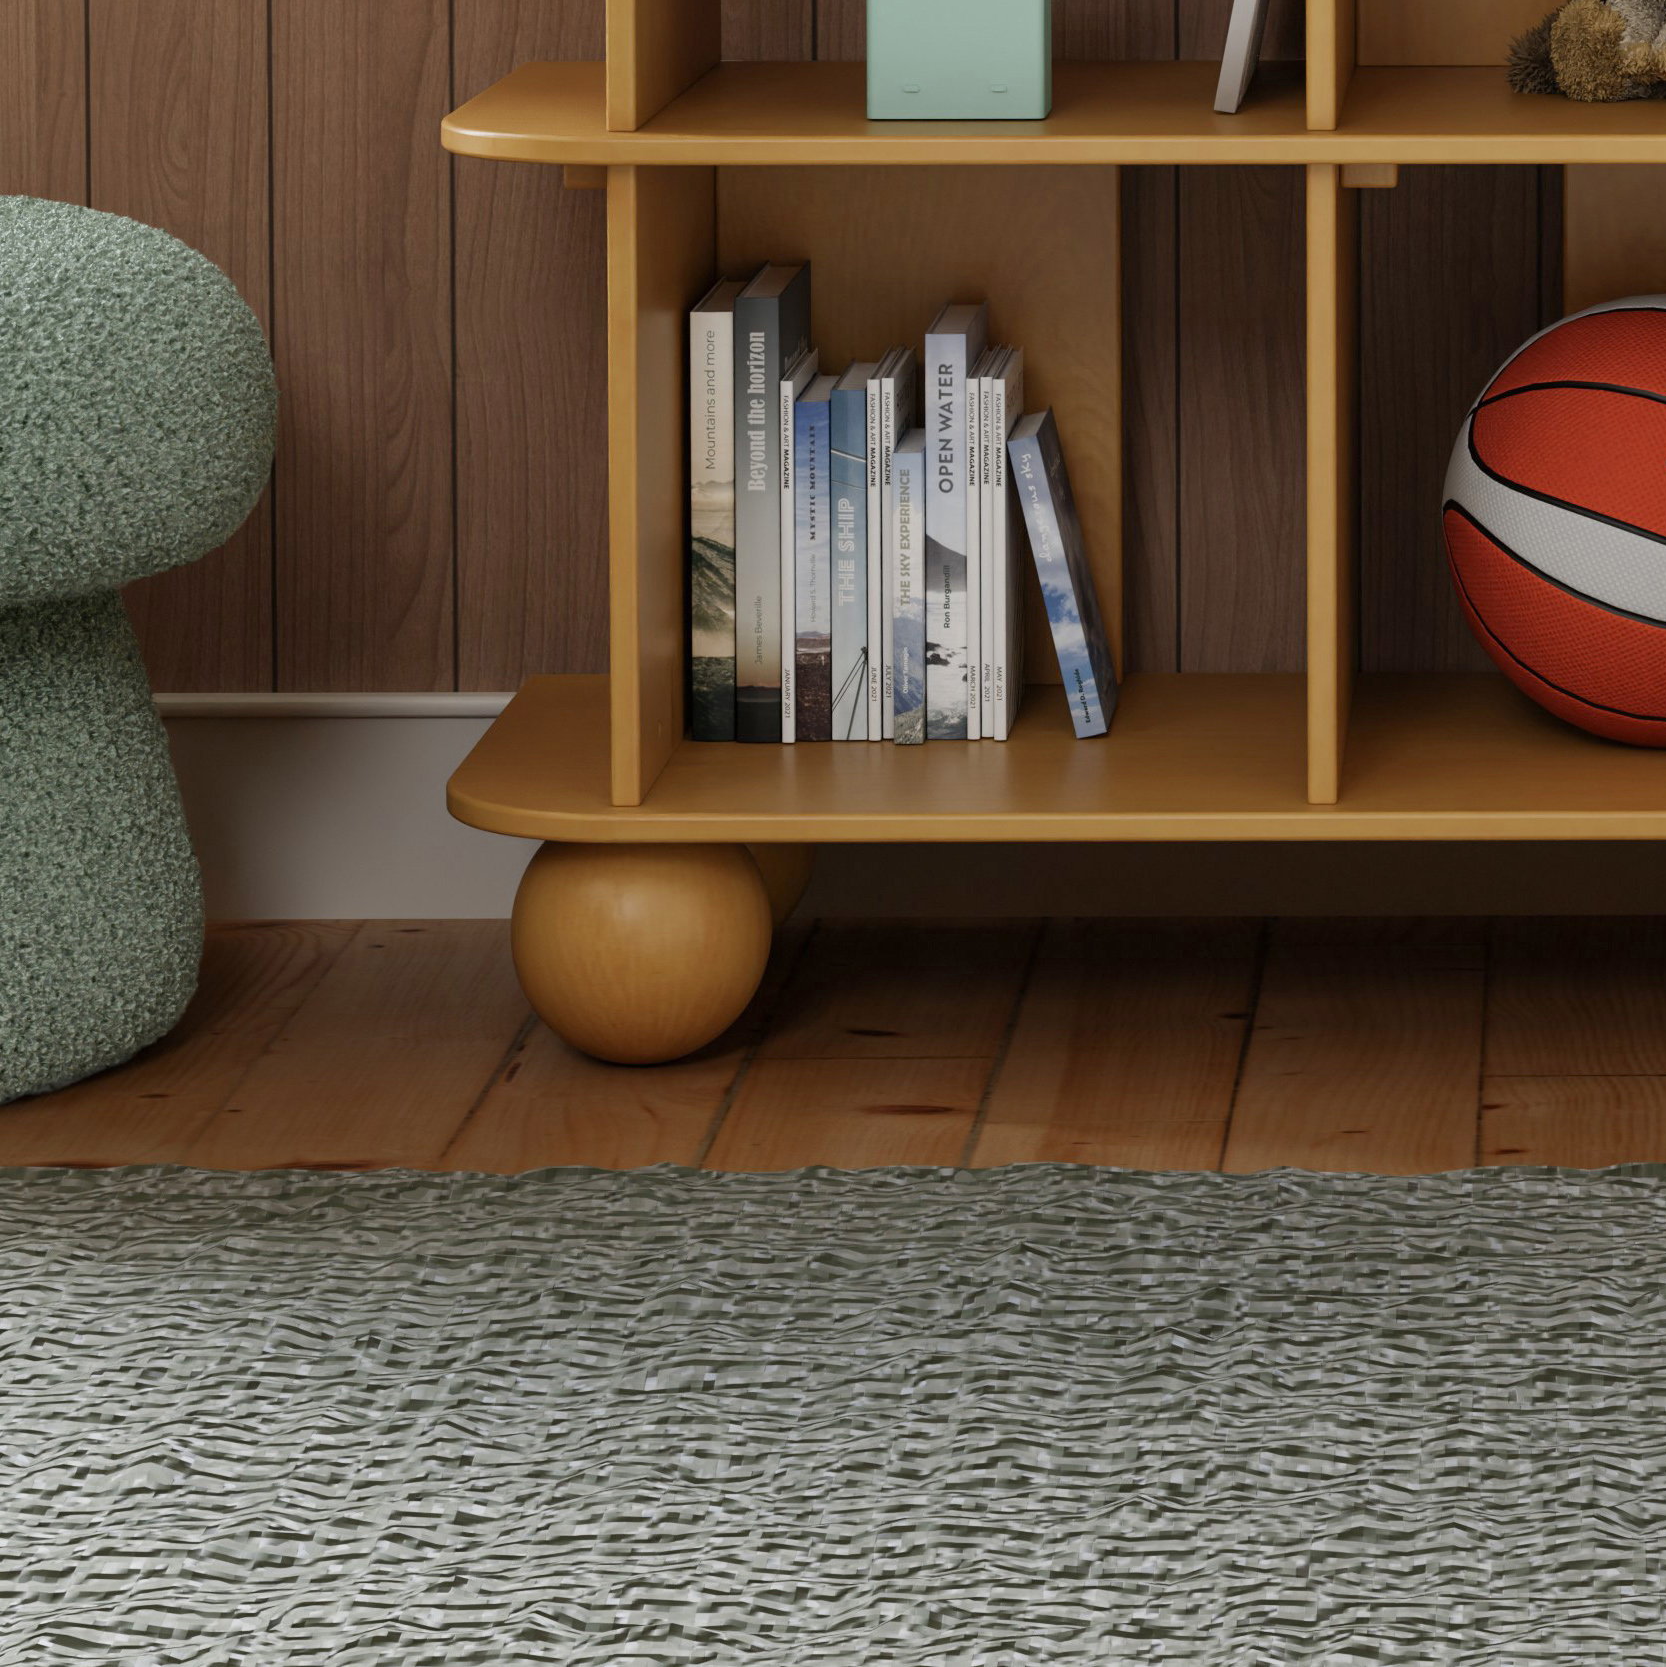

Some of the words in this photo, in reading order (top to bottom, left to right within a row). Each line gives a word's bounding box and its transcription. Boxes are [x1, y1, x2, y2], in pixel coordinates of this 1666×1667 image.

[705, 330, 716, 366] more
[747, 331, 766, 394] horizon
[704, 369, 716, 396] and
[938, 363, 953, 432] WATER
[705, 398, 716, 470] Mountains
[747, 398, 766, 425] the
[747, 430, 768, 491] Beyond
[938, 438, 954, 493] OPEN
[838, 498, 855, 552] SHIP
[900, 469, 910, 550] EXPERIENCE
[1028, 486, 1053, 562] dangerous
[838, 559, 855, 606] THE
[900, 553, 911, 577] SKY
[809, 595, 817, 622] Howard
[900, 580, 911, 606] THE
[754, 635, 763, 665] James
[1081, 701, 1091, 724] Edward
